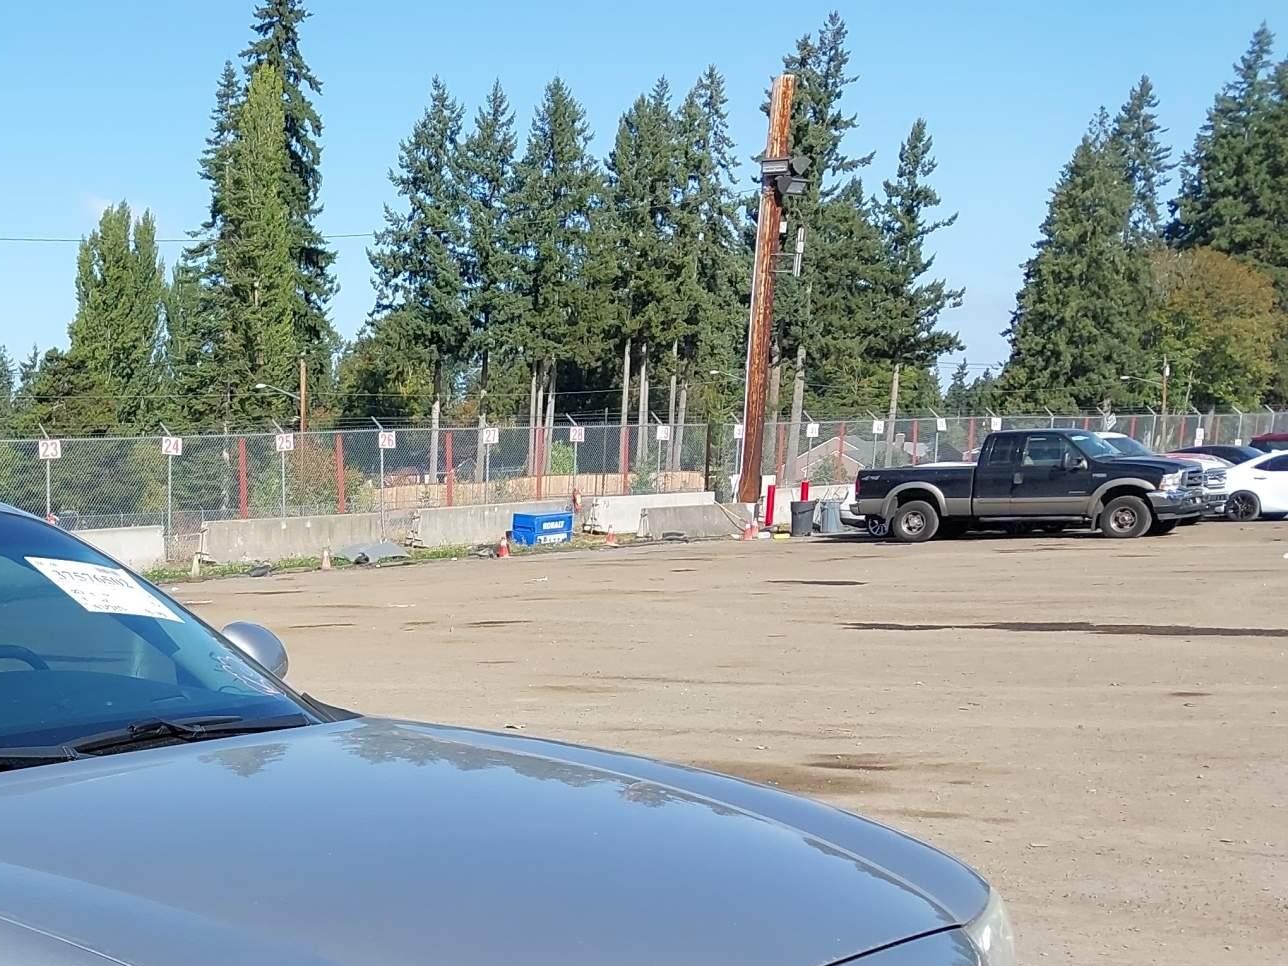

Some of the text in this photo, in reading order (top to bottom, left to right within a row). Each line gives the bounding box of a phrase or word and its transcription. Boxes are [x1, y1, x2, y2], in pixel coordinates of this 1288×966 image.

[278, 436, 292, 449] 25
[380, 433, 394, 447] 26
[484, 430, 497, 442] 27
[40, 442, 58, 457] 23
[163, 439, 179, 453] 24
